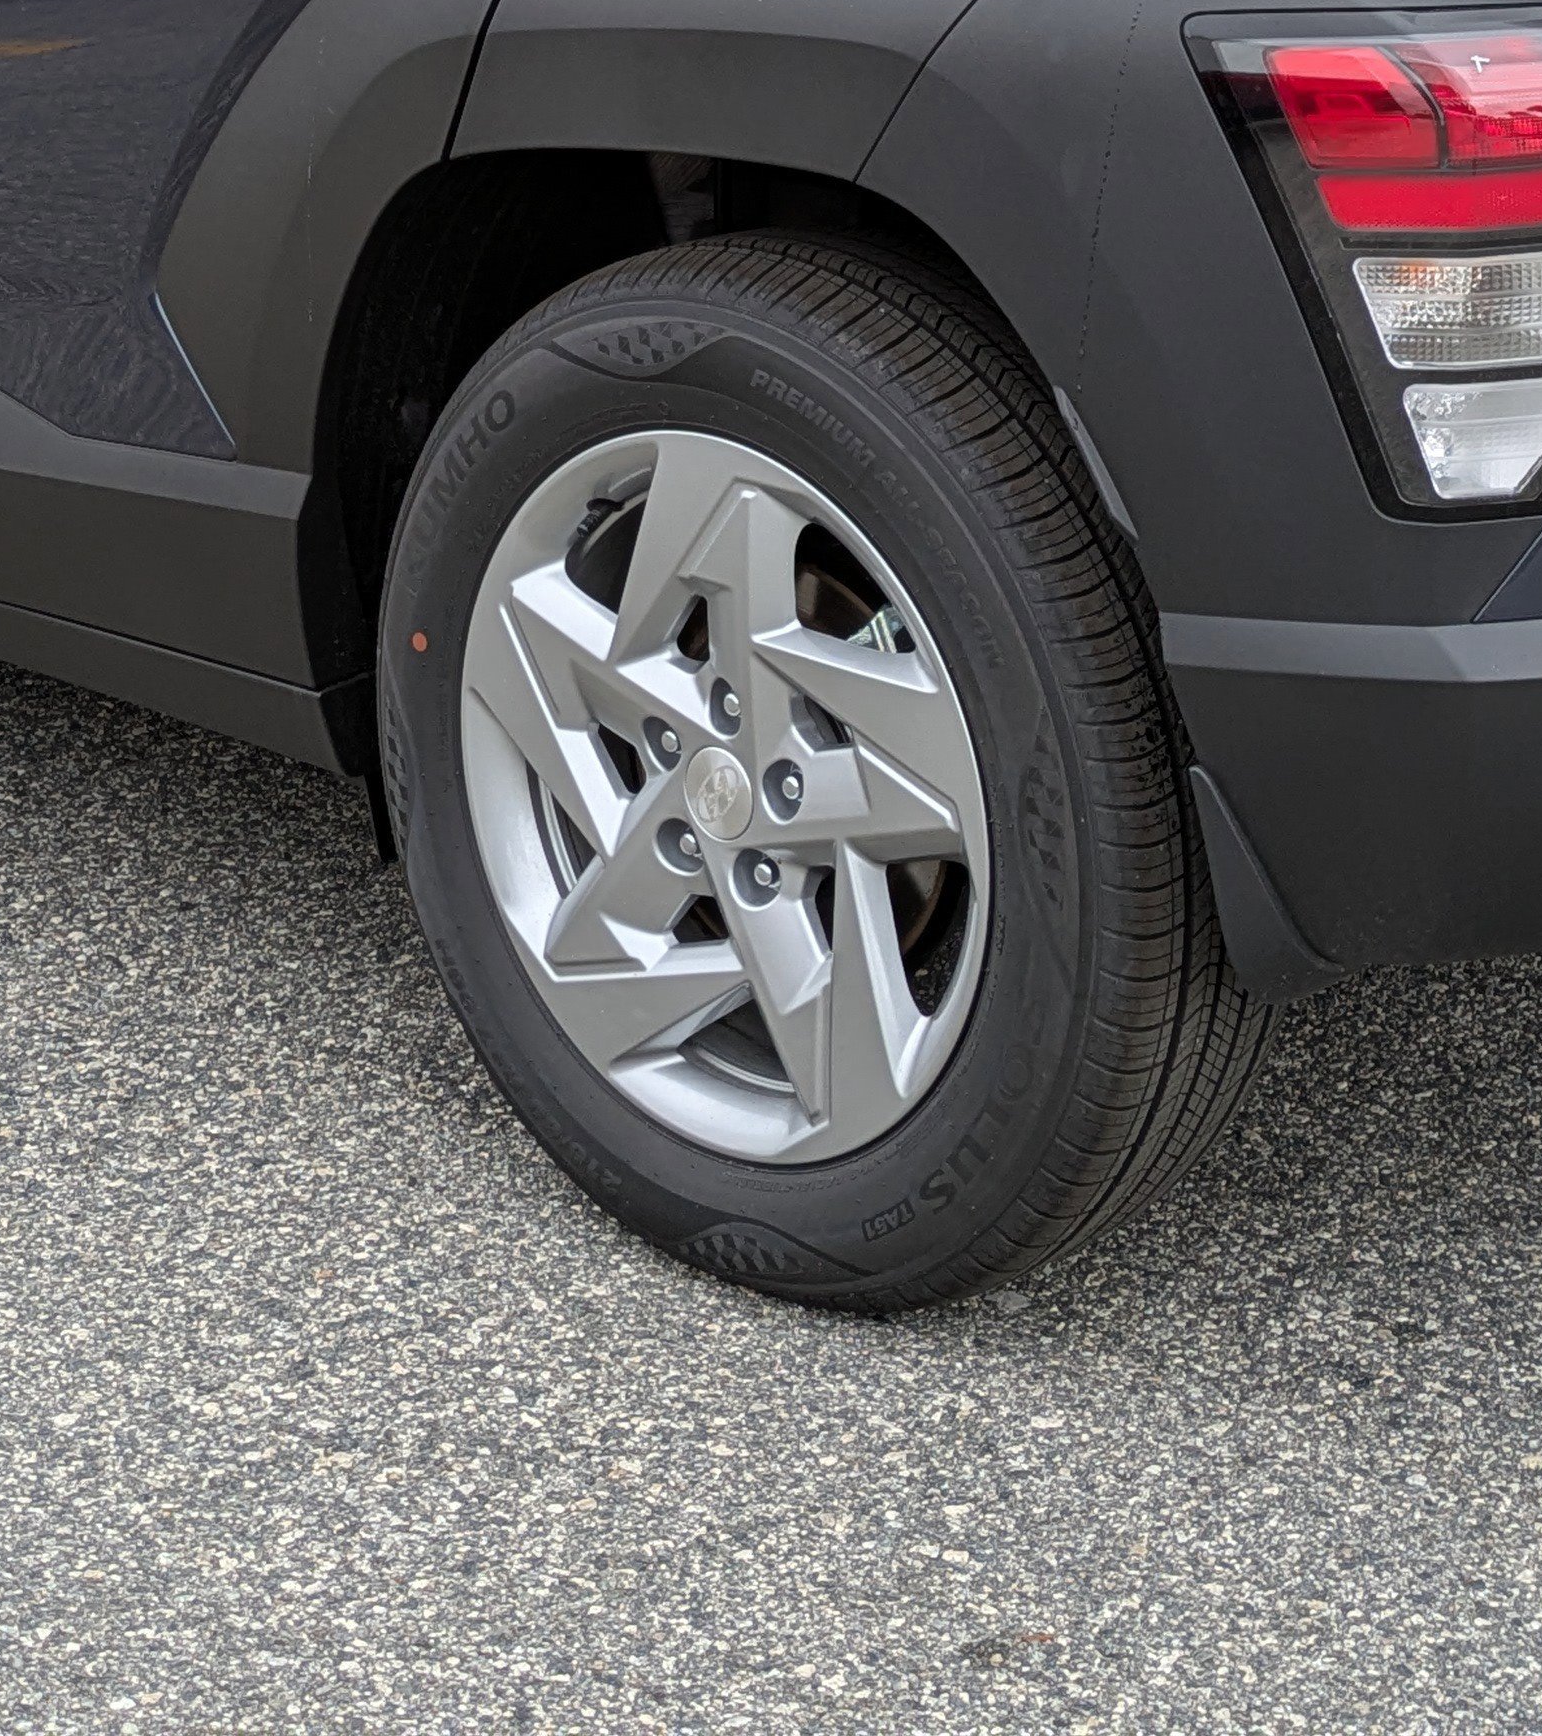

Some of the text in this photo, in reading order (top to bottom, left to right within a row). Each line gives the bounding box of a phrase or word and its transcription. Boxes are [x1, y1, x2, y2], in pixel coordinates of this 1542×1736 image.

[748, 367, 877, 468] PREMIUM
[401, 388, 517, 594] KUMHO
[861, 1198, 916, 1243] TA51
